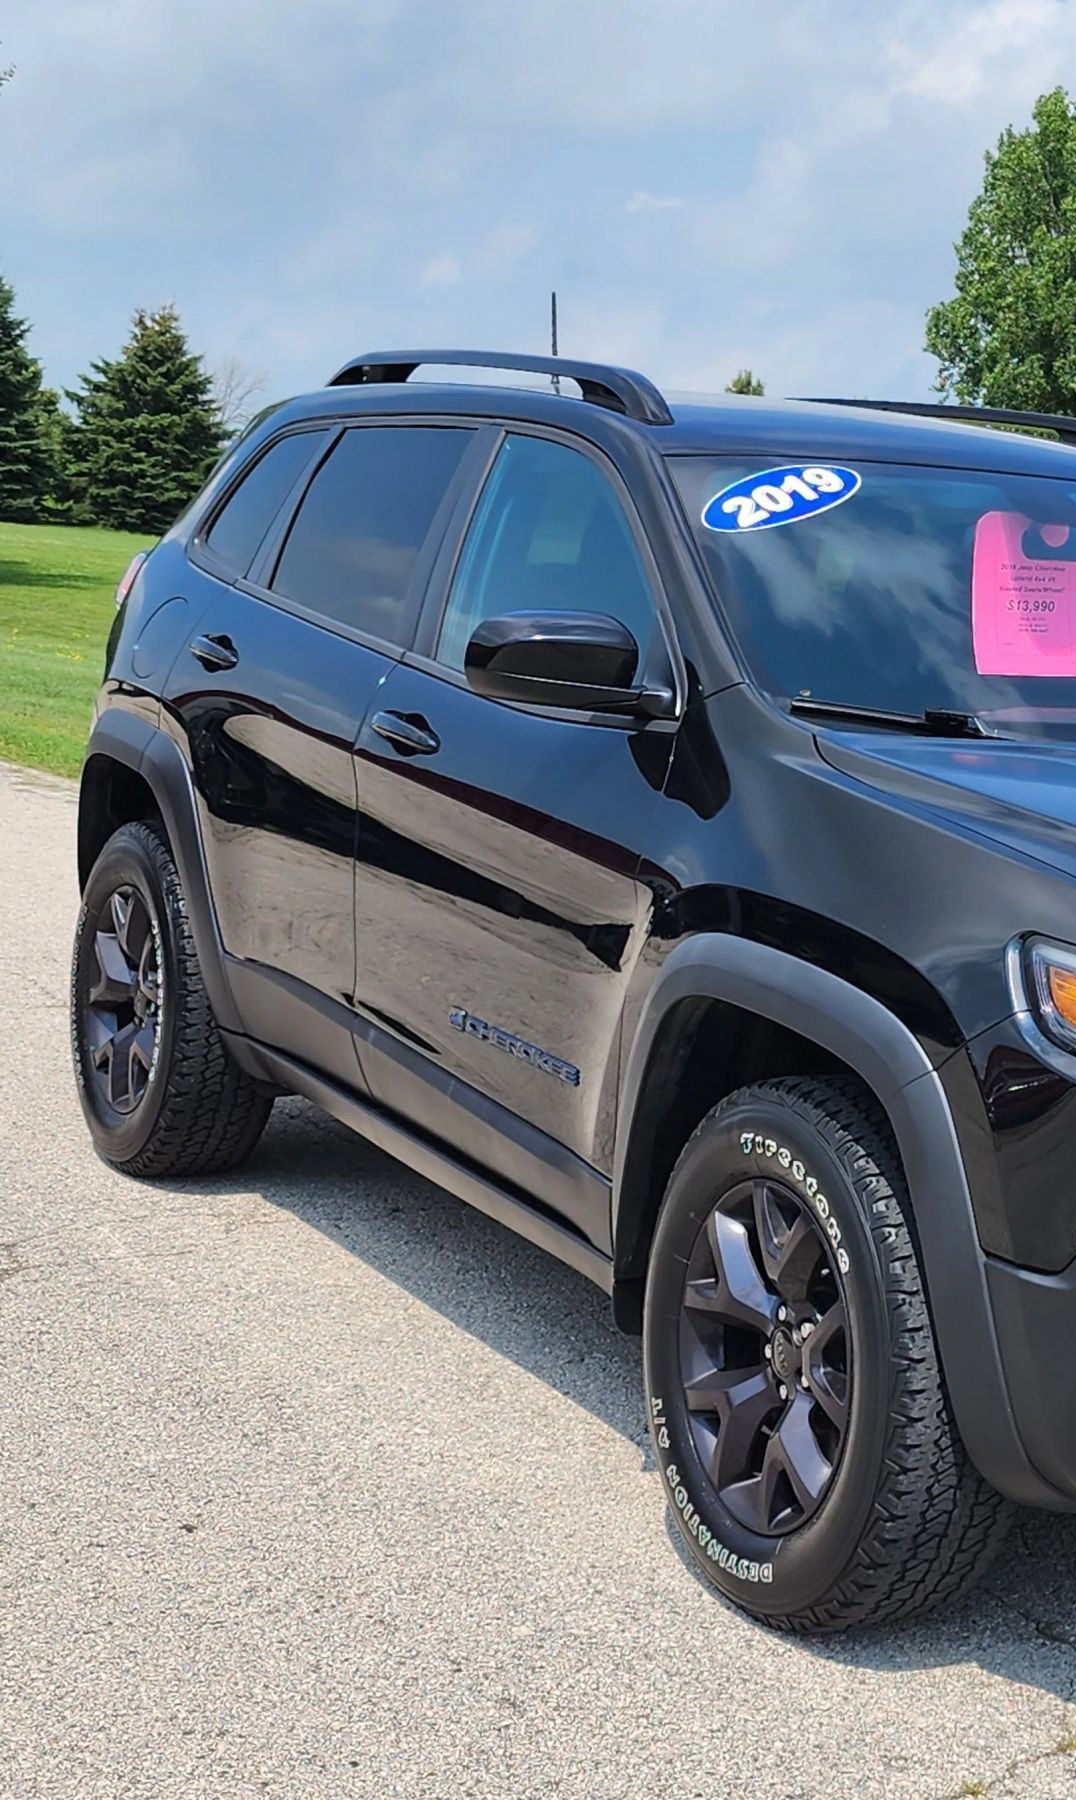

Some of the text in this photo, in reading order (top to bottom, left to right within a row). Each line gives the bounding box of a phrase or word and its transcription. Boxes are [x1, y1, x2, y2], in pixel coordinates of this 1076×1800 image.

[721, 467, 845, 528] 2019
[1007, 599, 1056, 613] $13,990
[666, 1463, 774, 1584] DESTINATION
